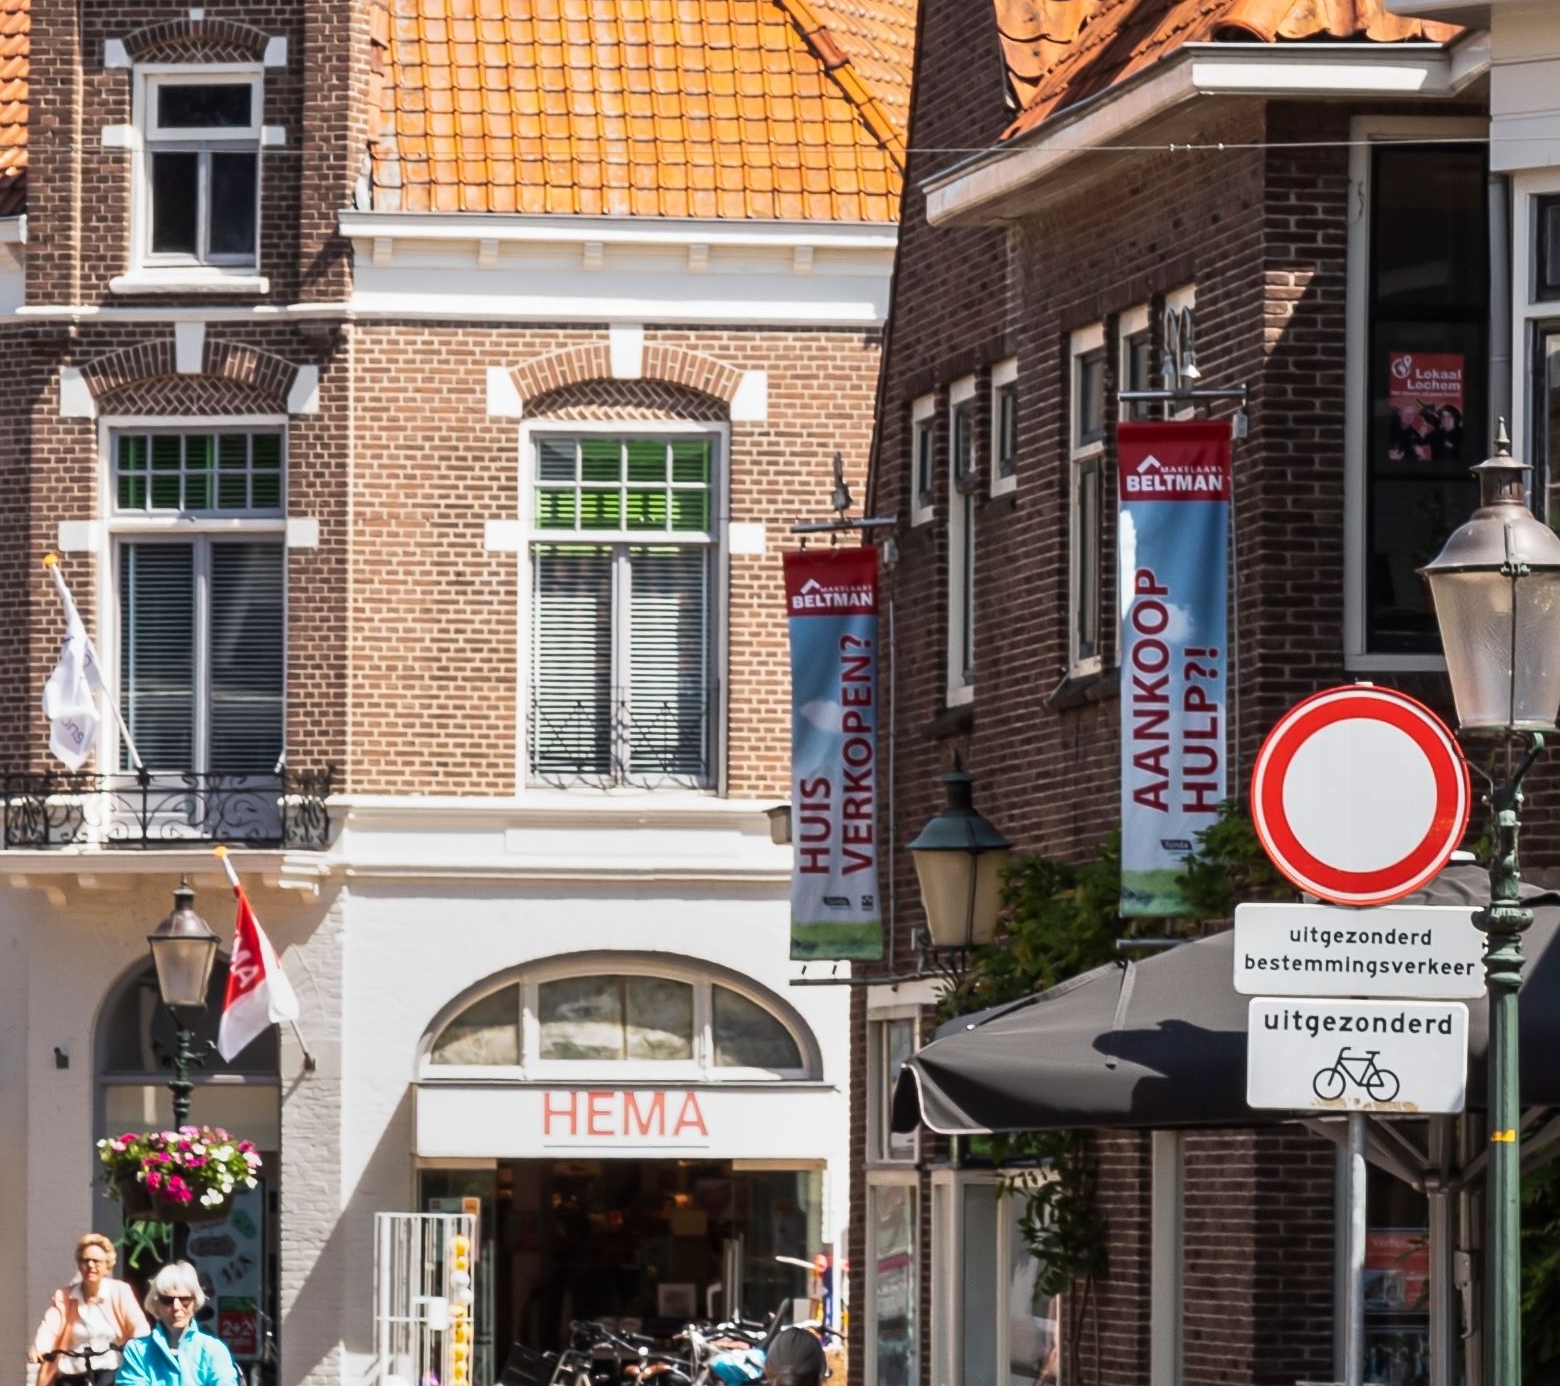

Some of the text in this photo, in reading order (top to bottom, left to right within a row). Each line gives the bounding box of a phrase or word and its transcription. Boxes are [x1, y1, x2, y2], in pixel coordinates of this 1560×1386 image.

[1407, 379, 1461, 390] Lochem
[1415, 369, 1462, 379] Lokaal
[1126, 474, 1223, 492] BELTMAN
[792, 592, 874, 609] BELTMAN
[1132, 568, 1170, 813] AANKOOP
[1182, 647, 1219, 813] HULP?!
[840, 634, 873, 876] VERKOPEN?
[800, 776, 832, 874] HUIS
[1290, 926, 1432, 948] uitgezonderd
[1245, 954, 1476, 979] bestemmingsverkeer
[1264, 1009, 1453, 1038] uitgezonderd
[543, 1090, 709, 1136] HEMA
